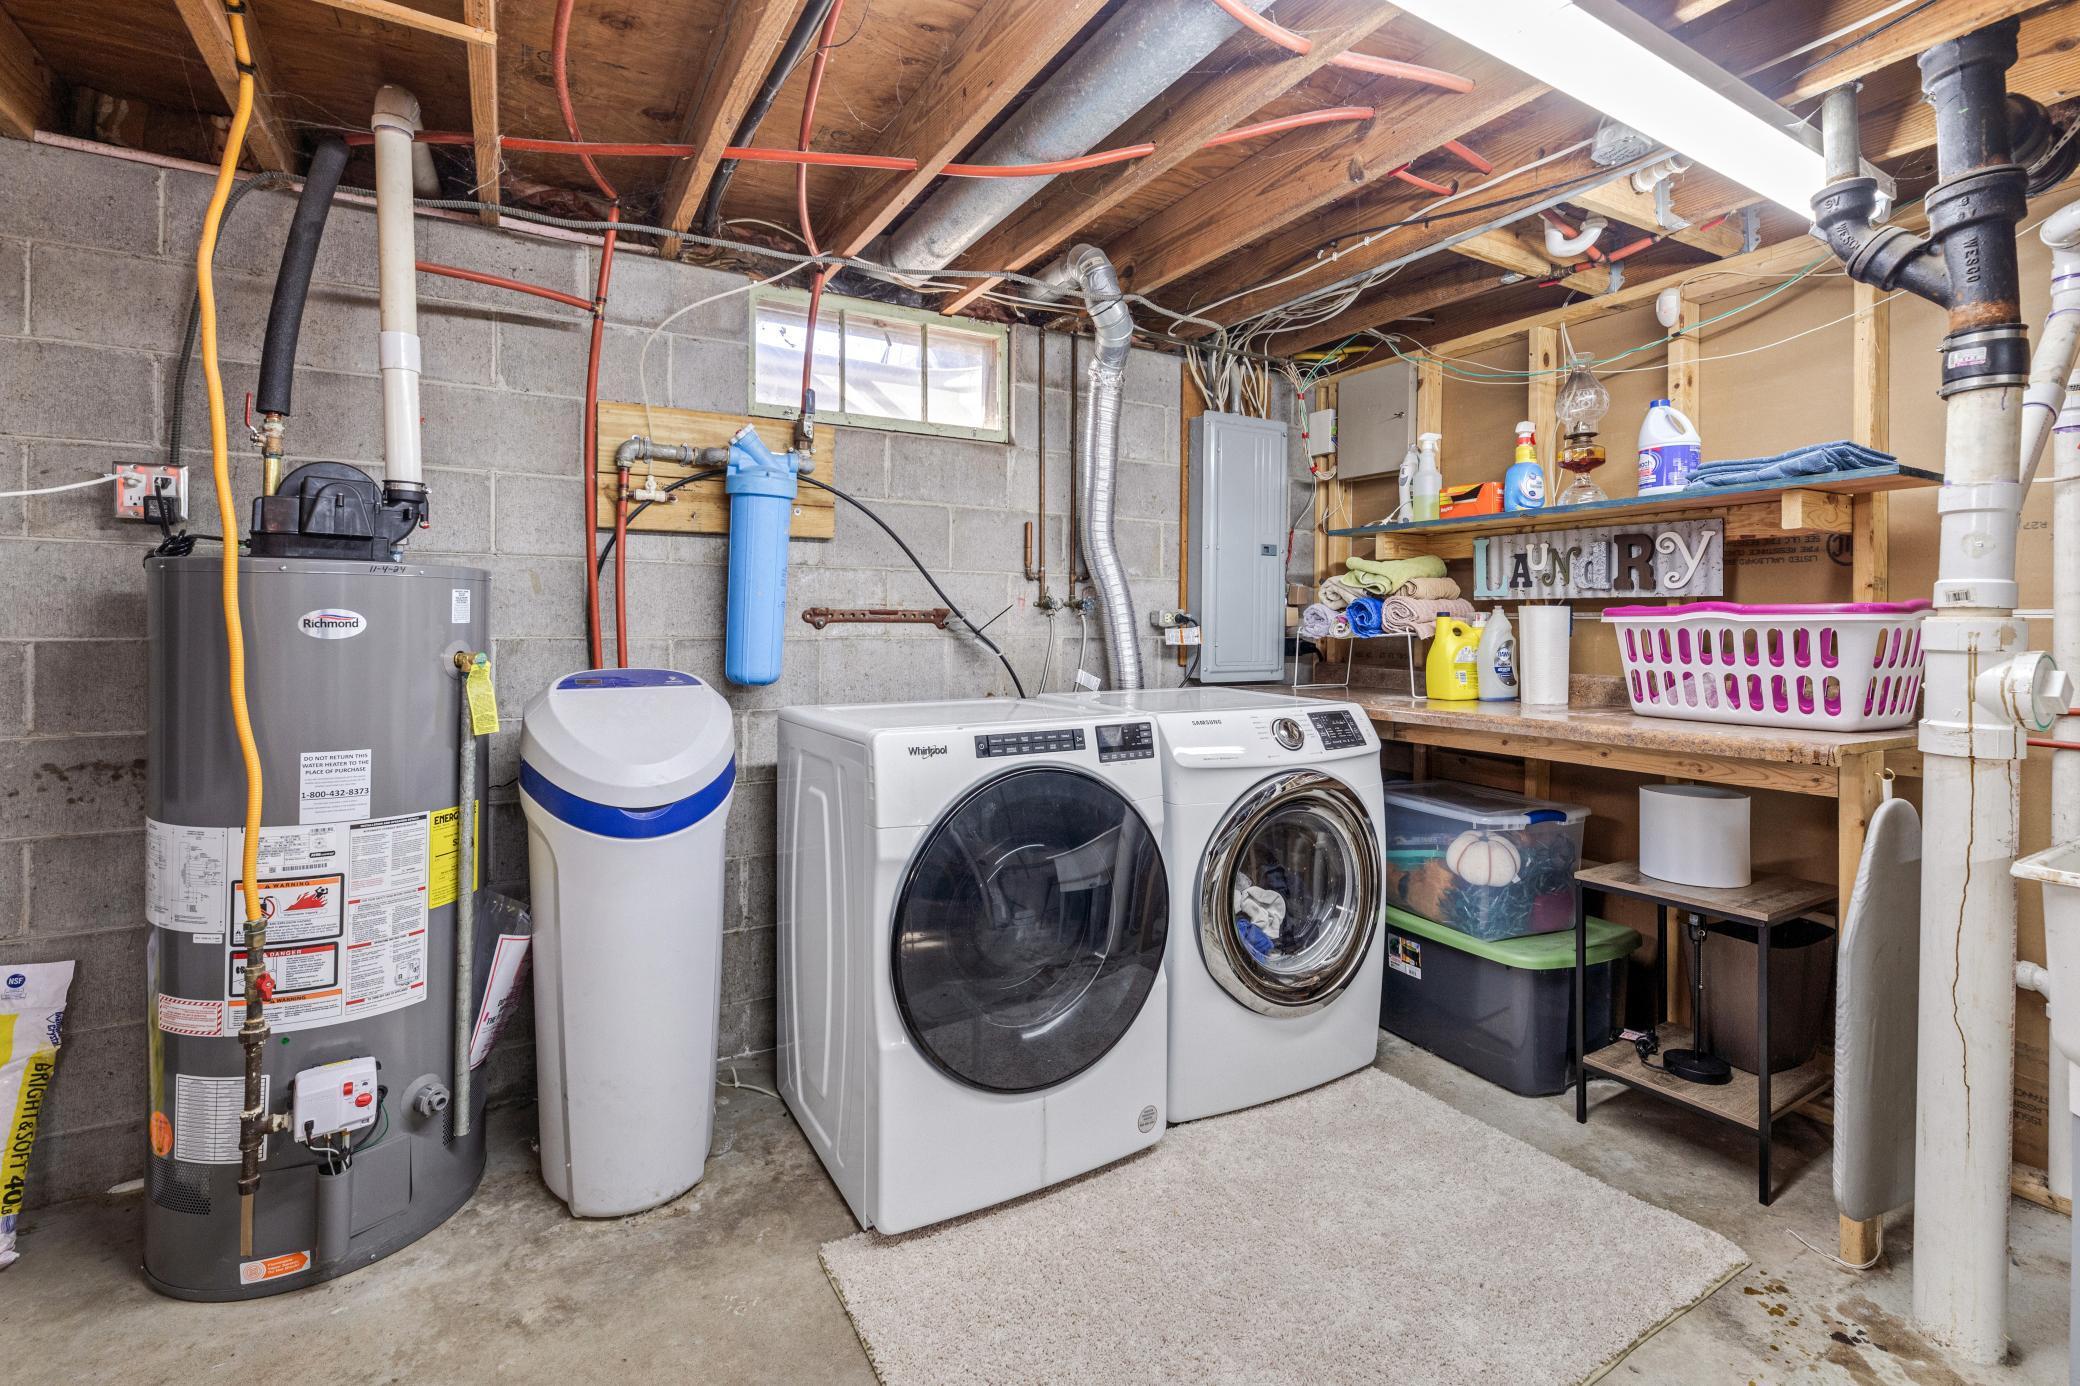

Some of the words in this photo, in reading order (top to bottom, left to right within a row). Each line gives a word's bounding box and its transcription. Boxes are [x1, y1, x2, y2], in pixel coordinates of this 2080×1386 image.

[1963, 236, 1981, 283] WESCO
[303, 618, 358, 628] Richmond
[908, 745, 948, 759] Whirlpool
[301, 787, 370, 799] 1-800-432-8373
[273, 881, 310, 889] WARNING
[270, 950, 302, 958] DANGER
[8, 977, 23, 985] NSF
[276, 995, 306, 1004] WARNING
